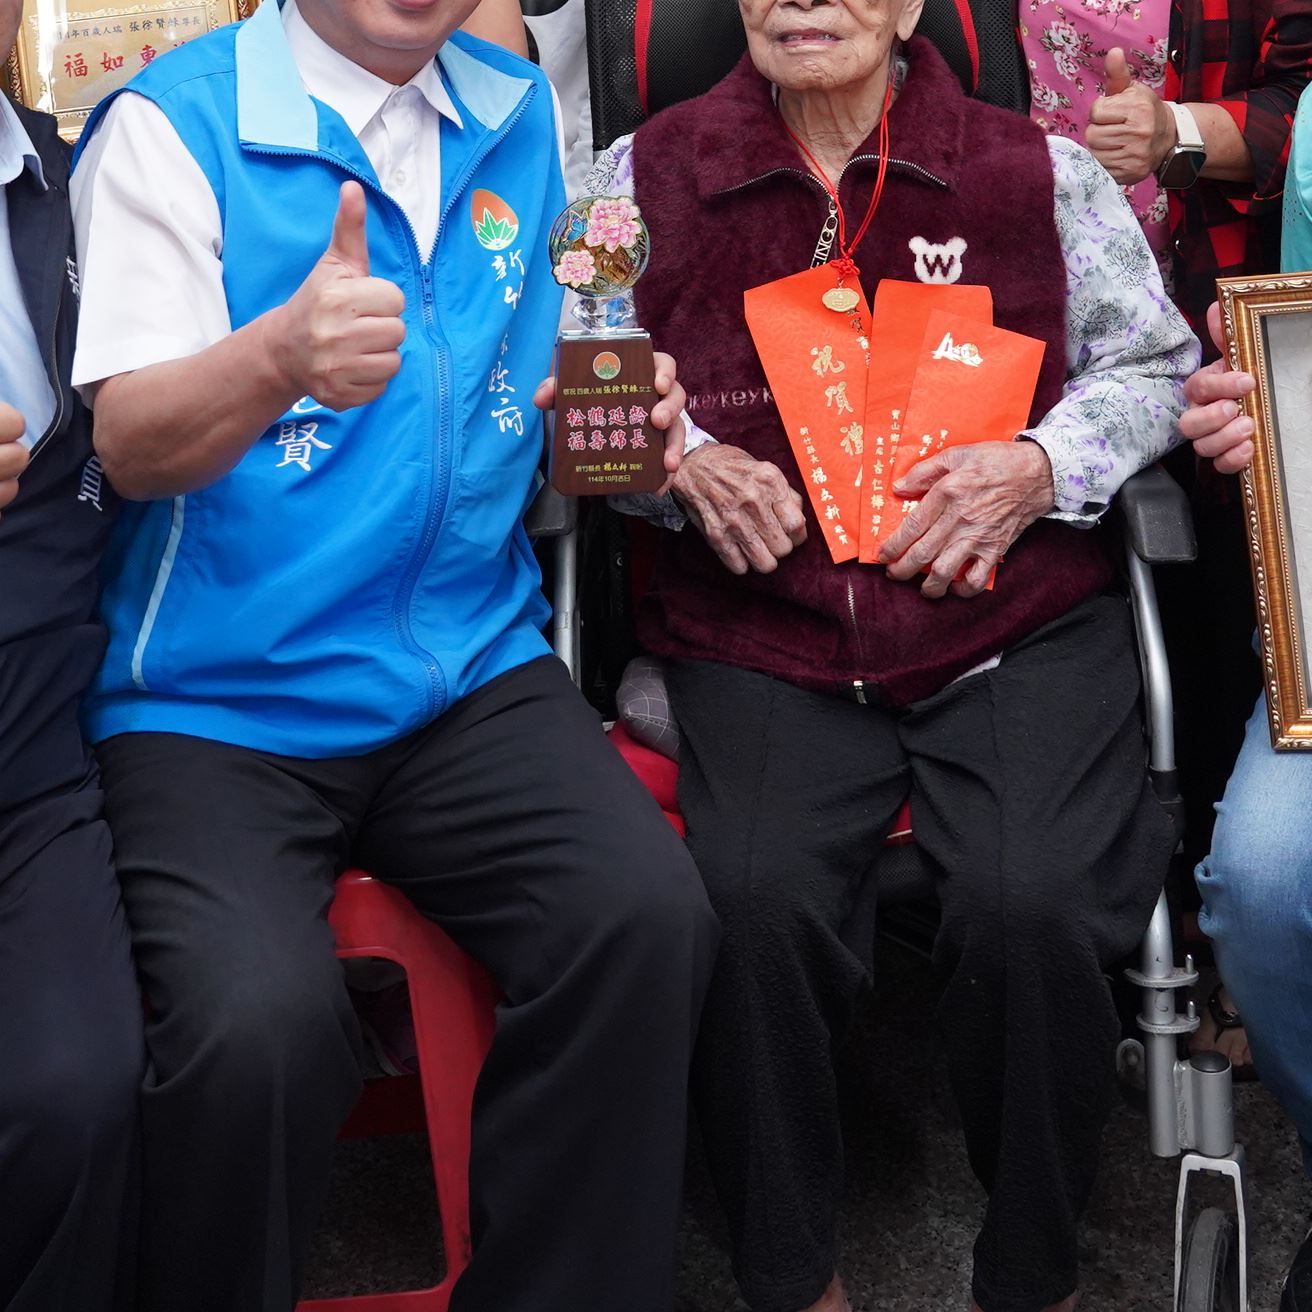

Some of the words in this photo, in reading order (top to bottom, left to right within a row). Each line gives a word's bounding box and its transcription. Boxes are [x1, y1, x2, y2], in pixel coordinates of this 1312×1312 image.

[64, 41, 186, 78] 福如東
[922, 252, 956, 280] W
[488, 248, 525, 437] 新政府
[567, 405, 648, 427] 松鶴延齡
[275, 396, 333, 472] 賢
[568, 429, 648, 451] 福壽綿長
